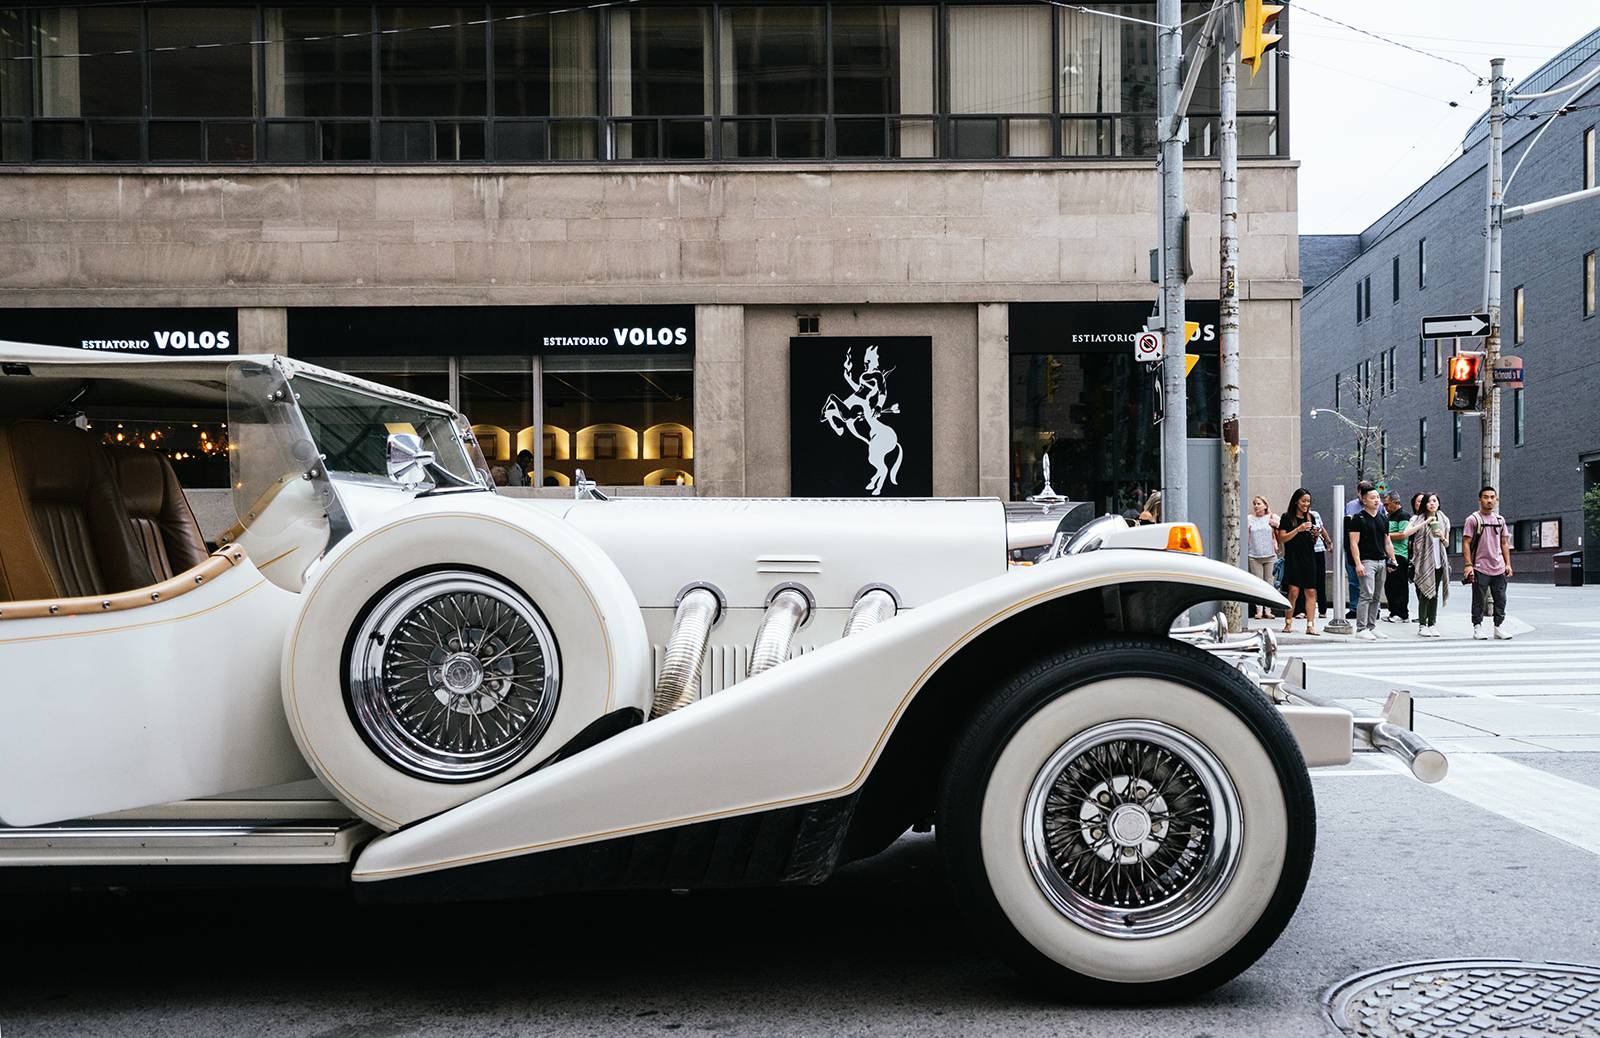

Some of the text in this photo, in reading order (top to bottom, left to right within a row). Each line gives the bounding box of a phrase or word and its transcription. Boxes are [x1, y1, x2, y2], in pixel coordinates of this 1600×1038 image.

[82, 331, 230, 349] ESTIATORIO VOLOS
[543, 327, 687, 346] ESTIATORIO VOLOS
[1072, 334, 1136, 343] ESTIATORIO
